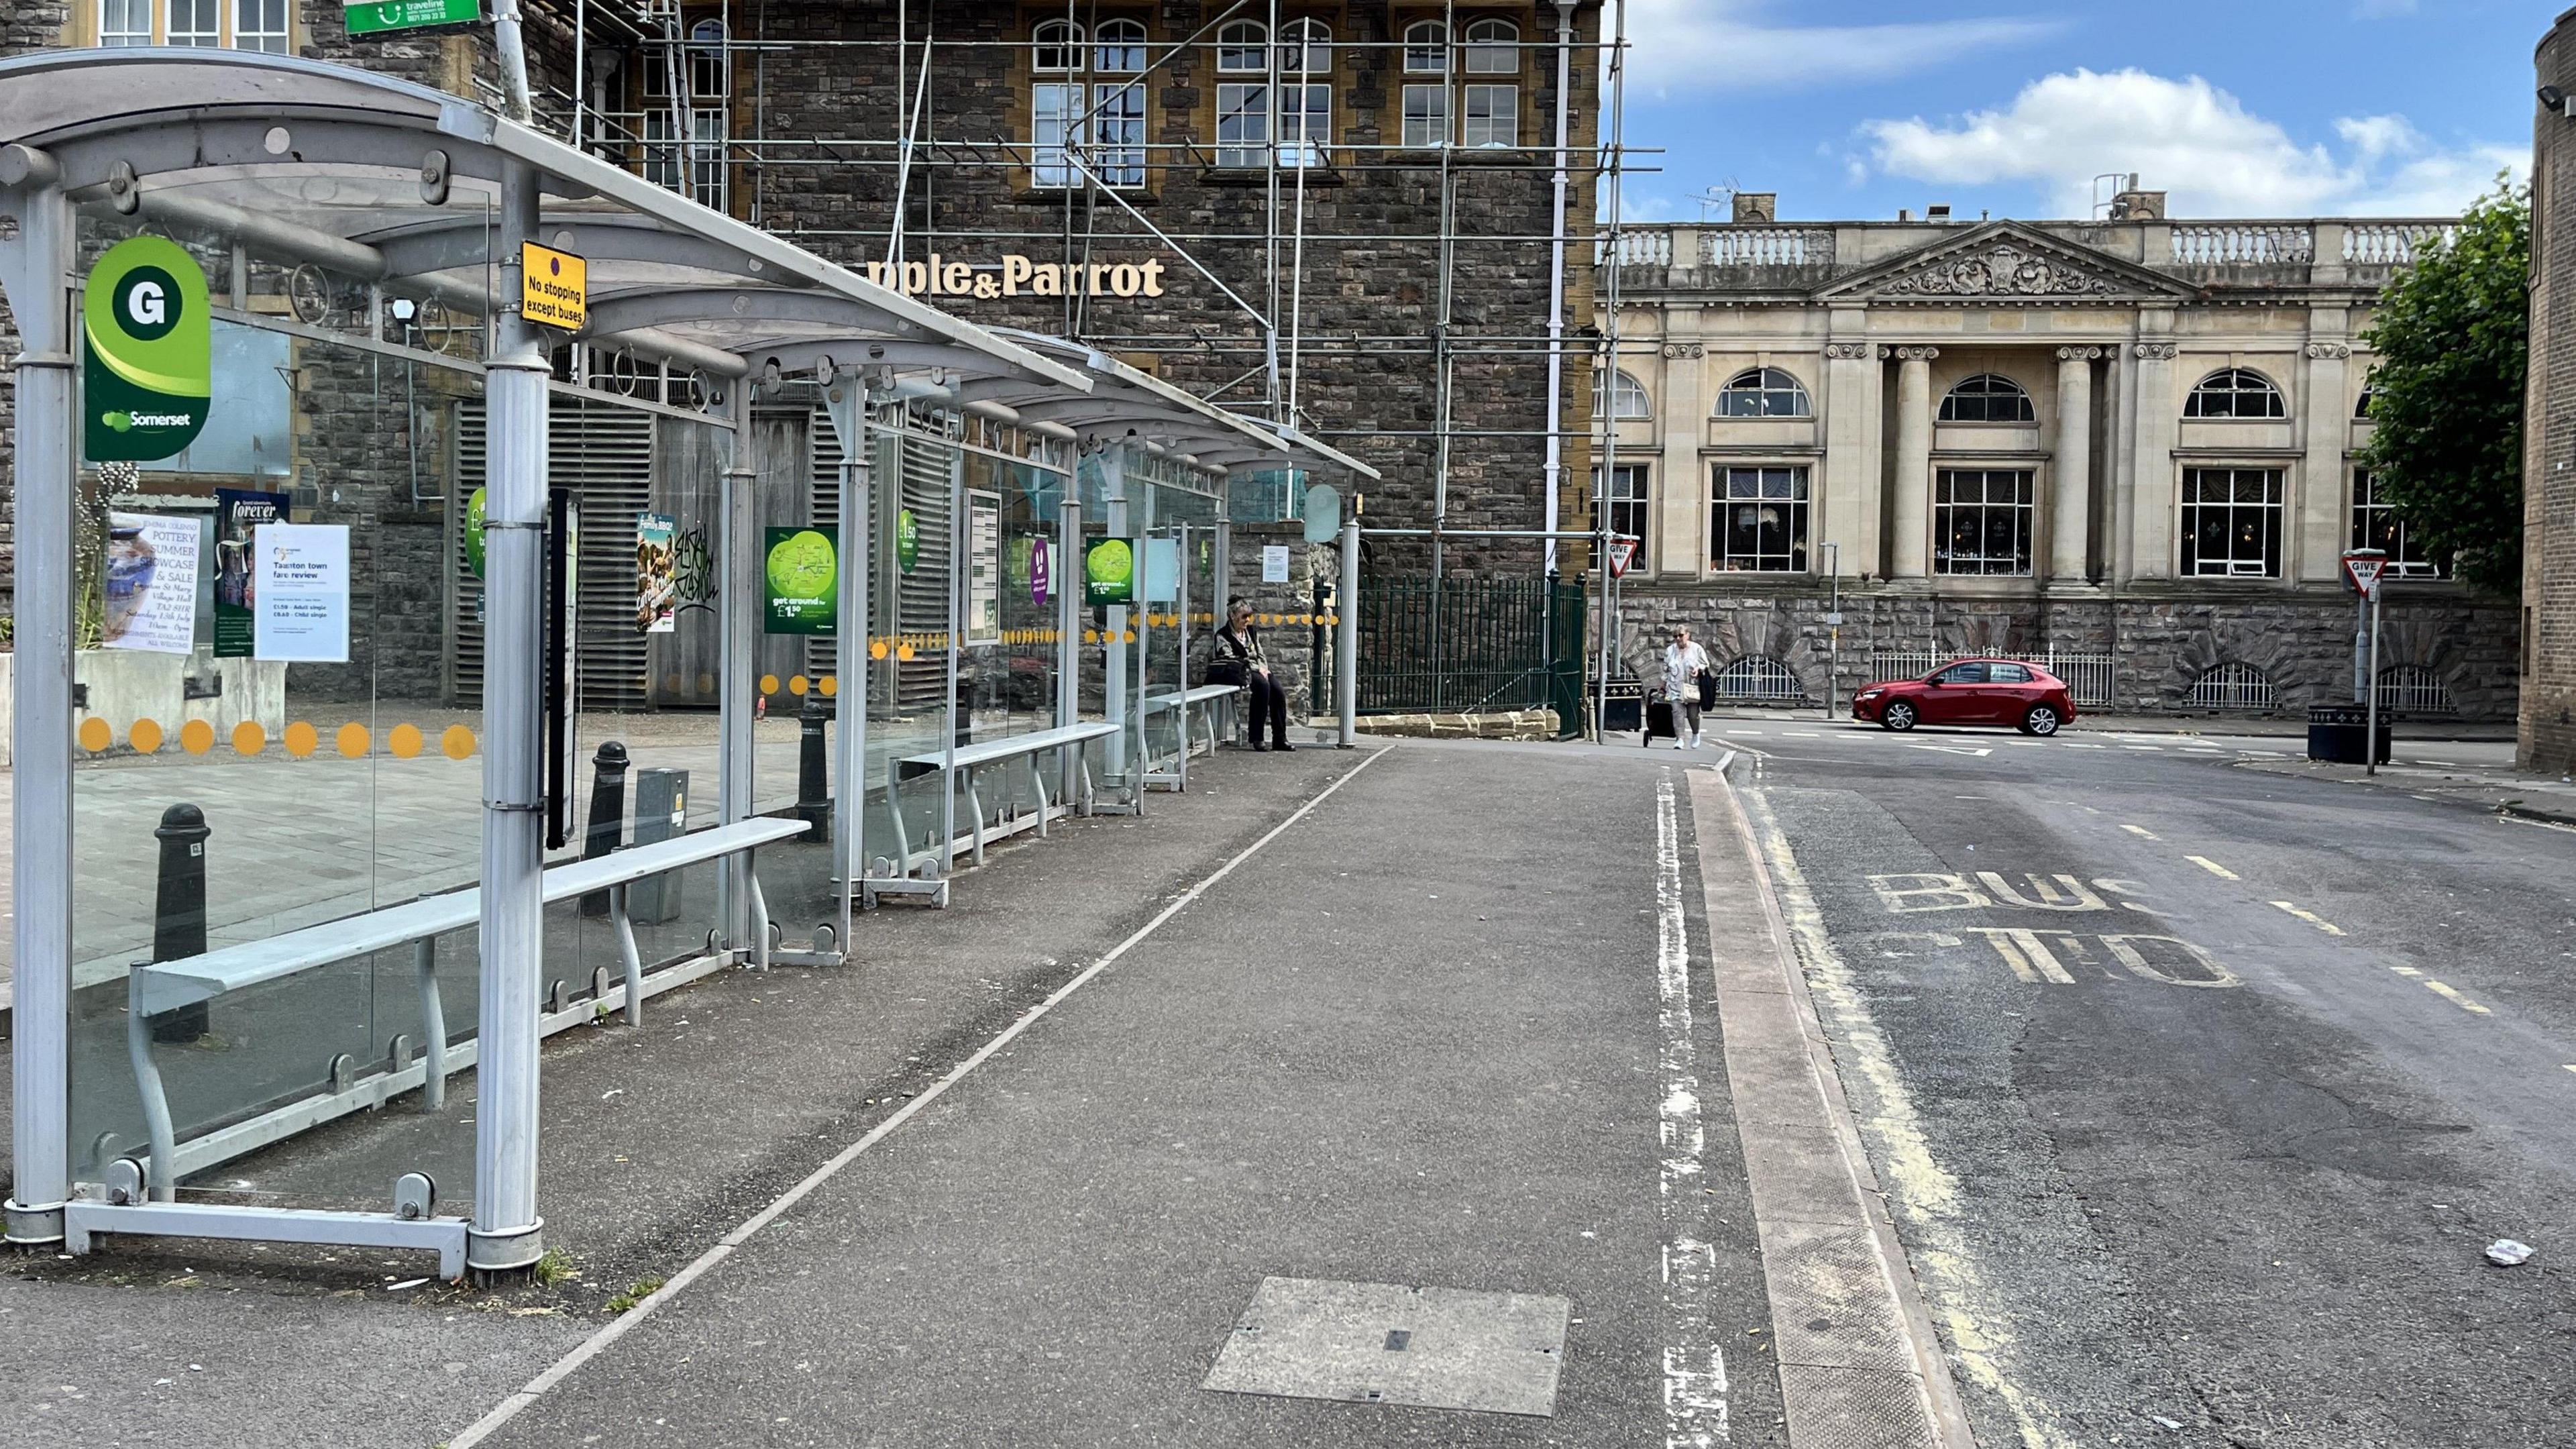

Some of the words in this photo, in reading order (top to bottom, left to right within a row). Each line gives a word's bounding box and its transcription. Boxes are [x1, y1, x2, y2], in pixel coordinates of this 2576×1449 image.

[406, 0, 445, 11] traveline
[529, 275, 541, 292] No
[544, 281, 581, 305] stopping
[128, 281, 165, 325] G
[527, 300, 556, 318] except
[558, 304, 582, 323] buses
[130, 411, 191, 426] Somerset
[231, 500, 276, 522] forever
[152, 531, 197, 543] POTTERY
[150, 544, 195, 556] SUMMER
[1610, 545, 1628, 553] GIVE
[140, 556, 195, 570] SHOWCASE
[273, 561, 306, 570] Taunton
[2352, 562, 2377, 571] GIVE
[156, 571, 166, 581] &
[167, 572, 194, 583] SALE
[772, 597, 788, 606] get
[788, 596, 818, 605] around
[776, 605, 802, 617] £1.50
